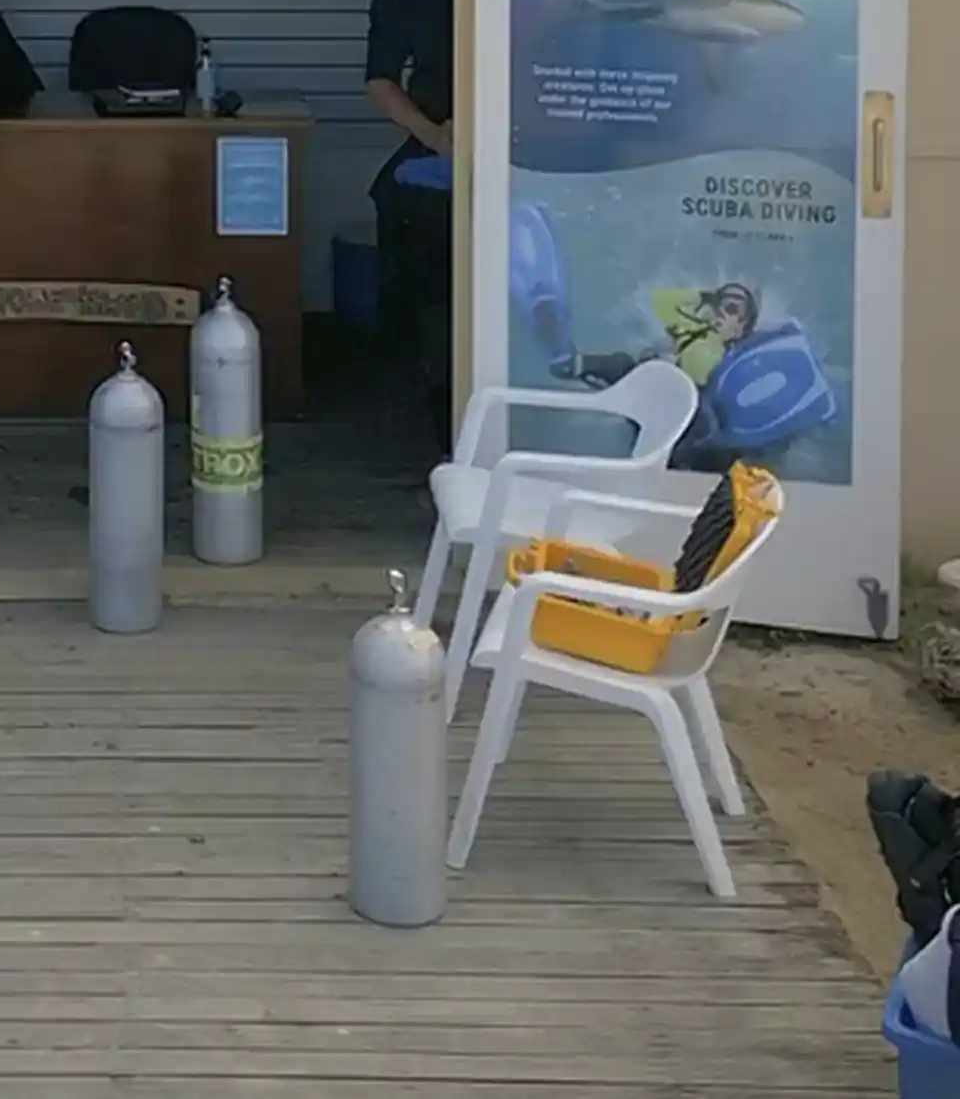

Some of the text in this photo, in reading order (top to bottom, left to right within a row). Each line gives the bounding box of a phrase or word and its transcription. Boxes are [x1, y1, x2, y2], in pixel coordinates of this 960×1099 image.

[704, 176, 813, 200] DISCOVER
[682, 196, 837, 225] SCUBA DIVING
